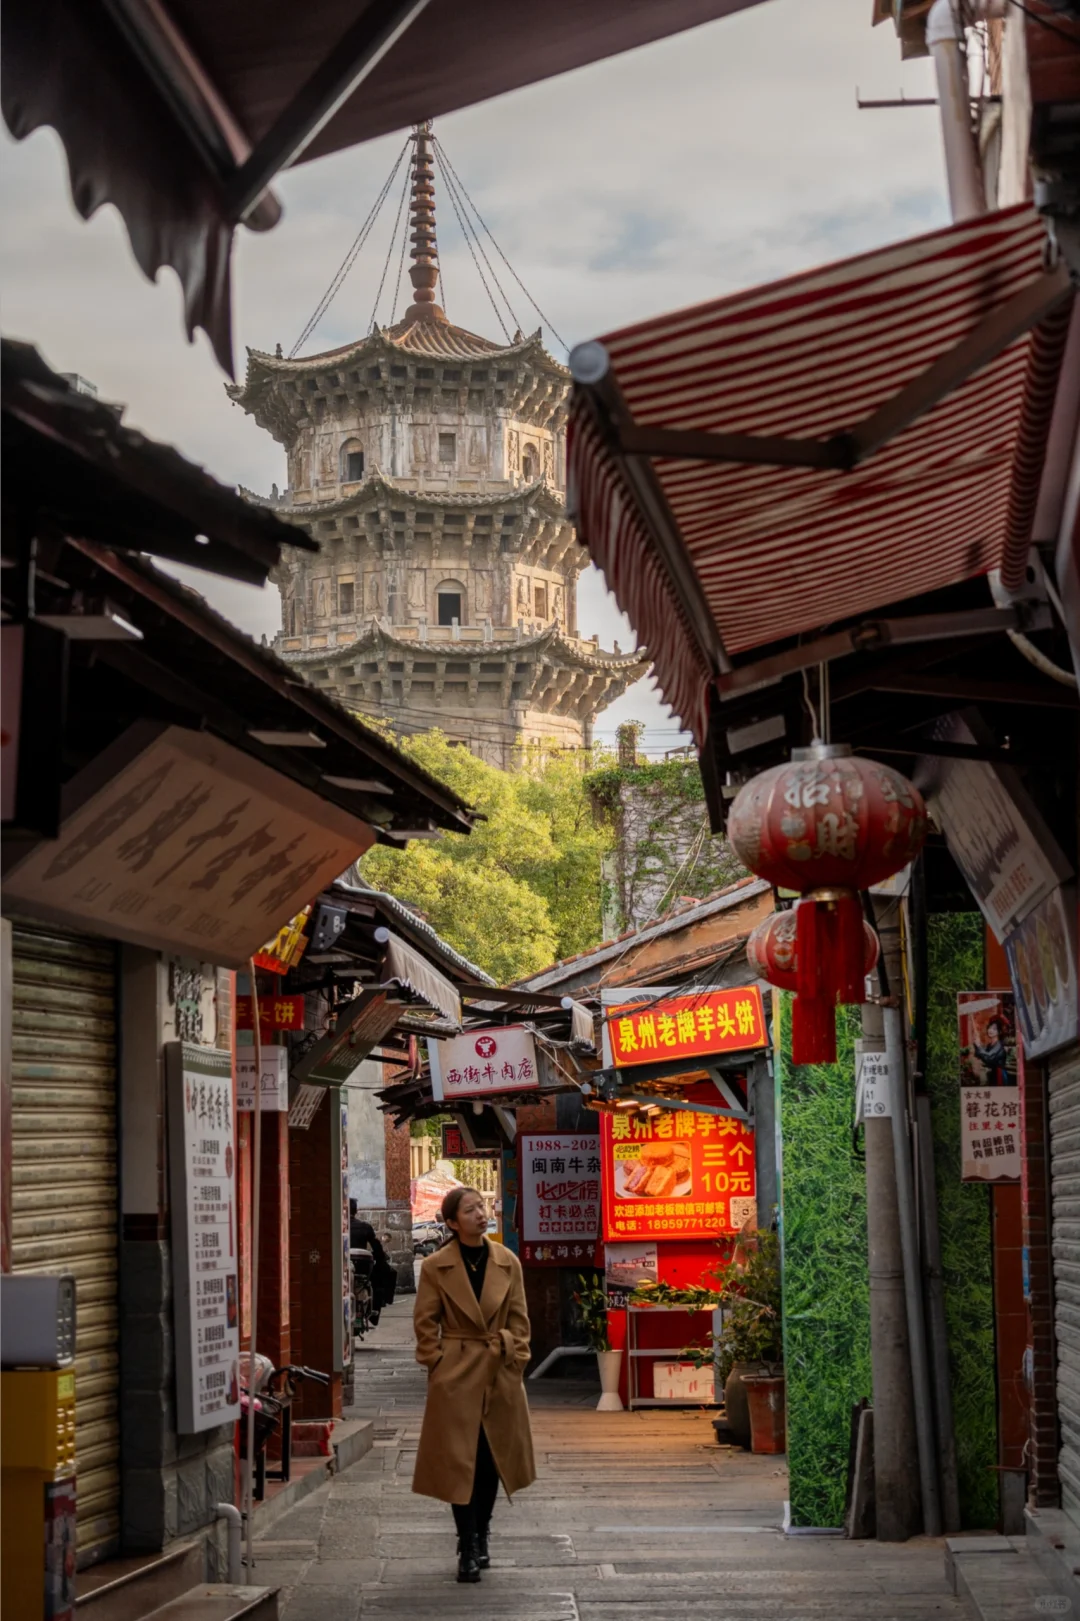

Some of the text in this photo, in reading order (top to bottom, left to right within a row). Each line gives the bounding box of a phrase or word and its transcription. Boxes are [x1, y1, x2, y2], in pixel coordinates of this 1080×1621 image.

[619, 1000, 756, 1053] 泉州老牌芋头饼
[446, 1057, 534, 1084] 西街牛肉店
[966, 1101, 1019, 1118] 簪花馆
[528, 1139, 600, 1152] 1988-202
[702, 1142, 753, 1167] 三个
[532, 1157, 601, 1174] 闽南牛杂
[701, 1171, 751, 1192] 10元
[539, 1204, 597, 1219] 打卡必点
[614, 1201, 726, 1218] 欢迎添加老板微信可邮寄
